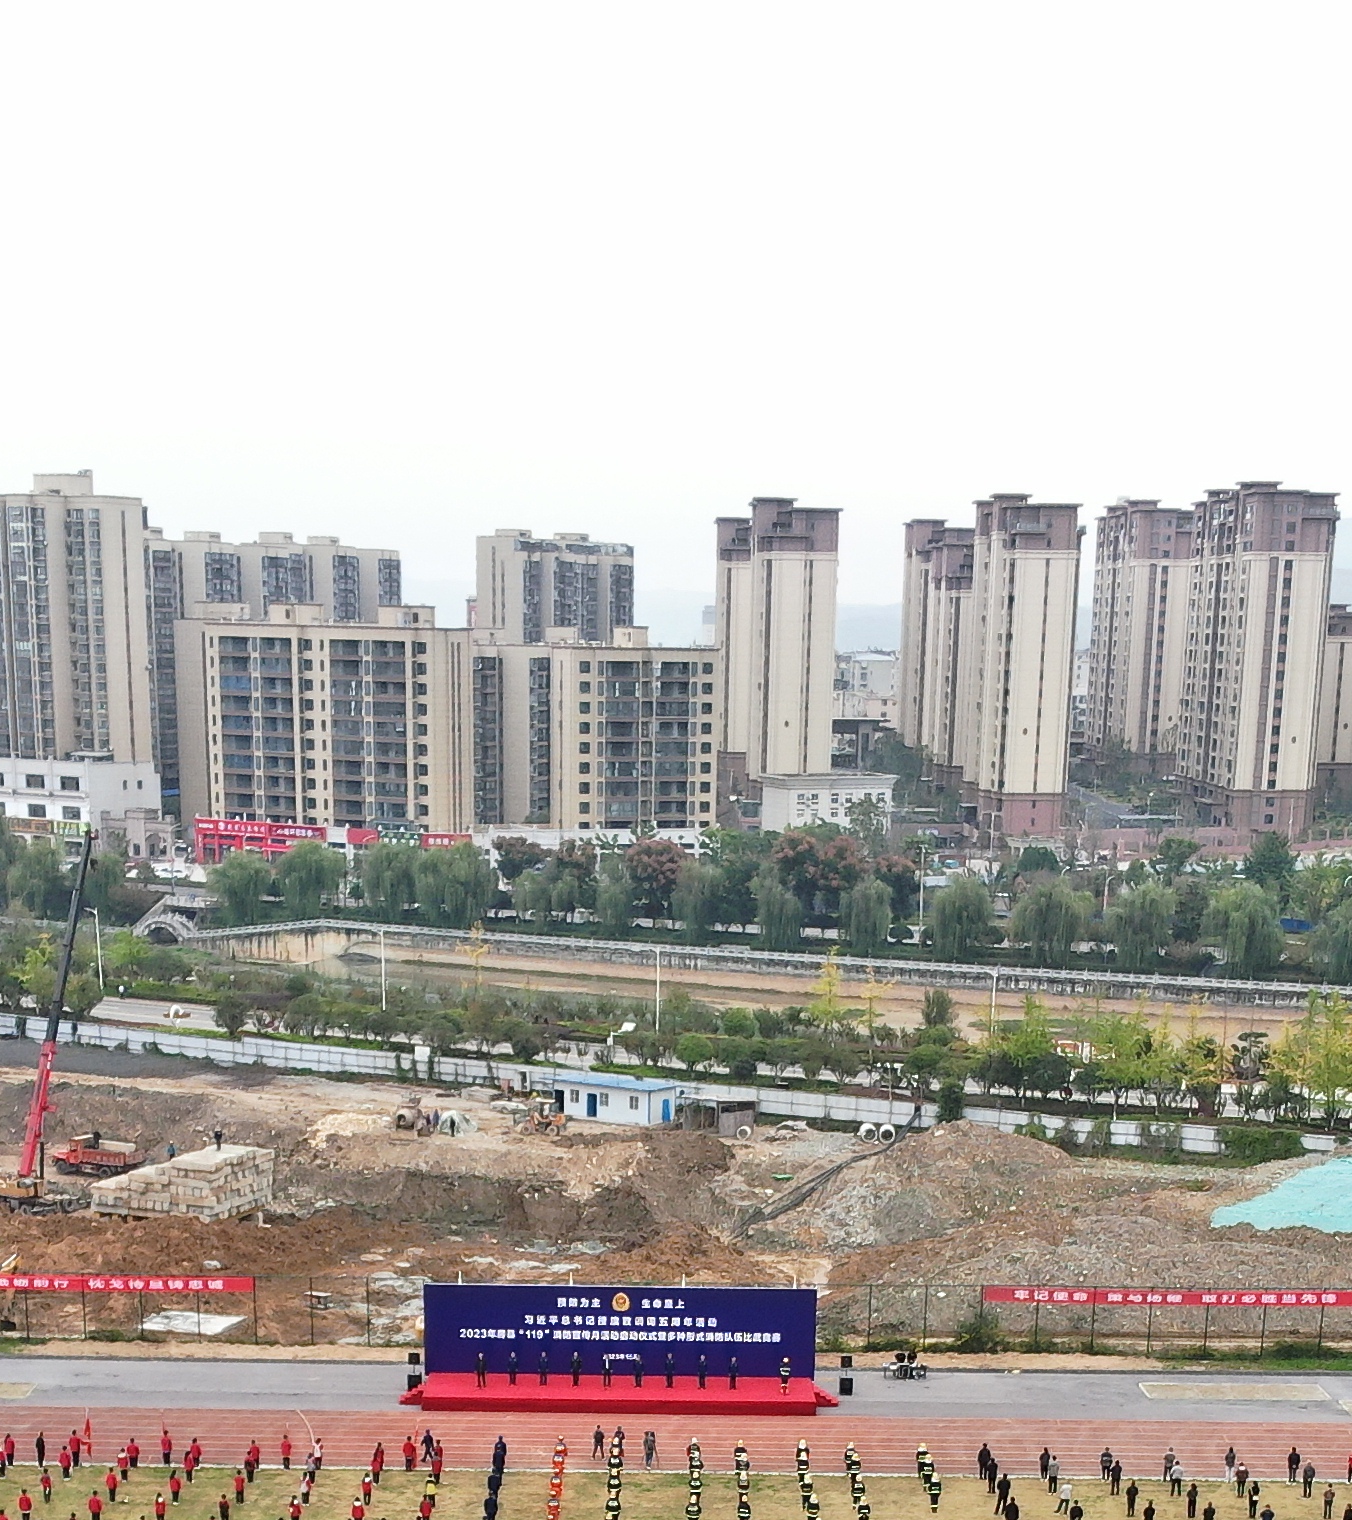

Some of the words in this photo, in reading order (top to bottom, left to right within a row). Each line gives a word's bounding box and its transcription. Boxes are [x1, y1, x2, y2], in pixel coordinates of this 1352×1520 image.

[1014, 1289, 1089, 1301] 牢记使命
[557, 1297, 601, 1308] 预防为主
[641, 1298, 685, 1310] 生命至上
